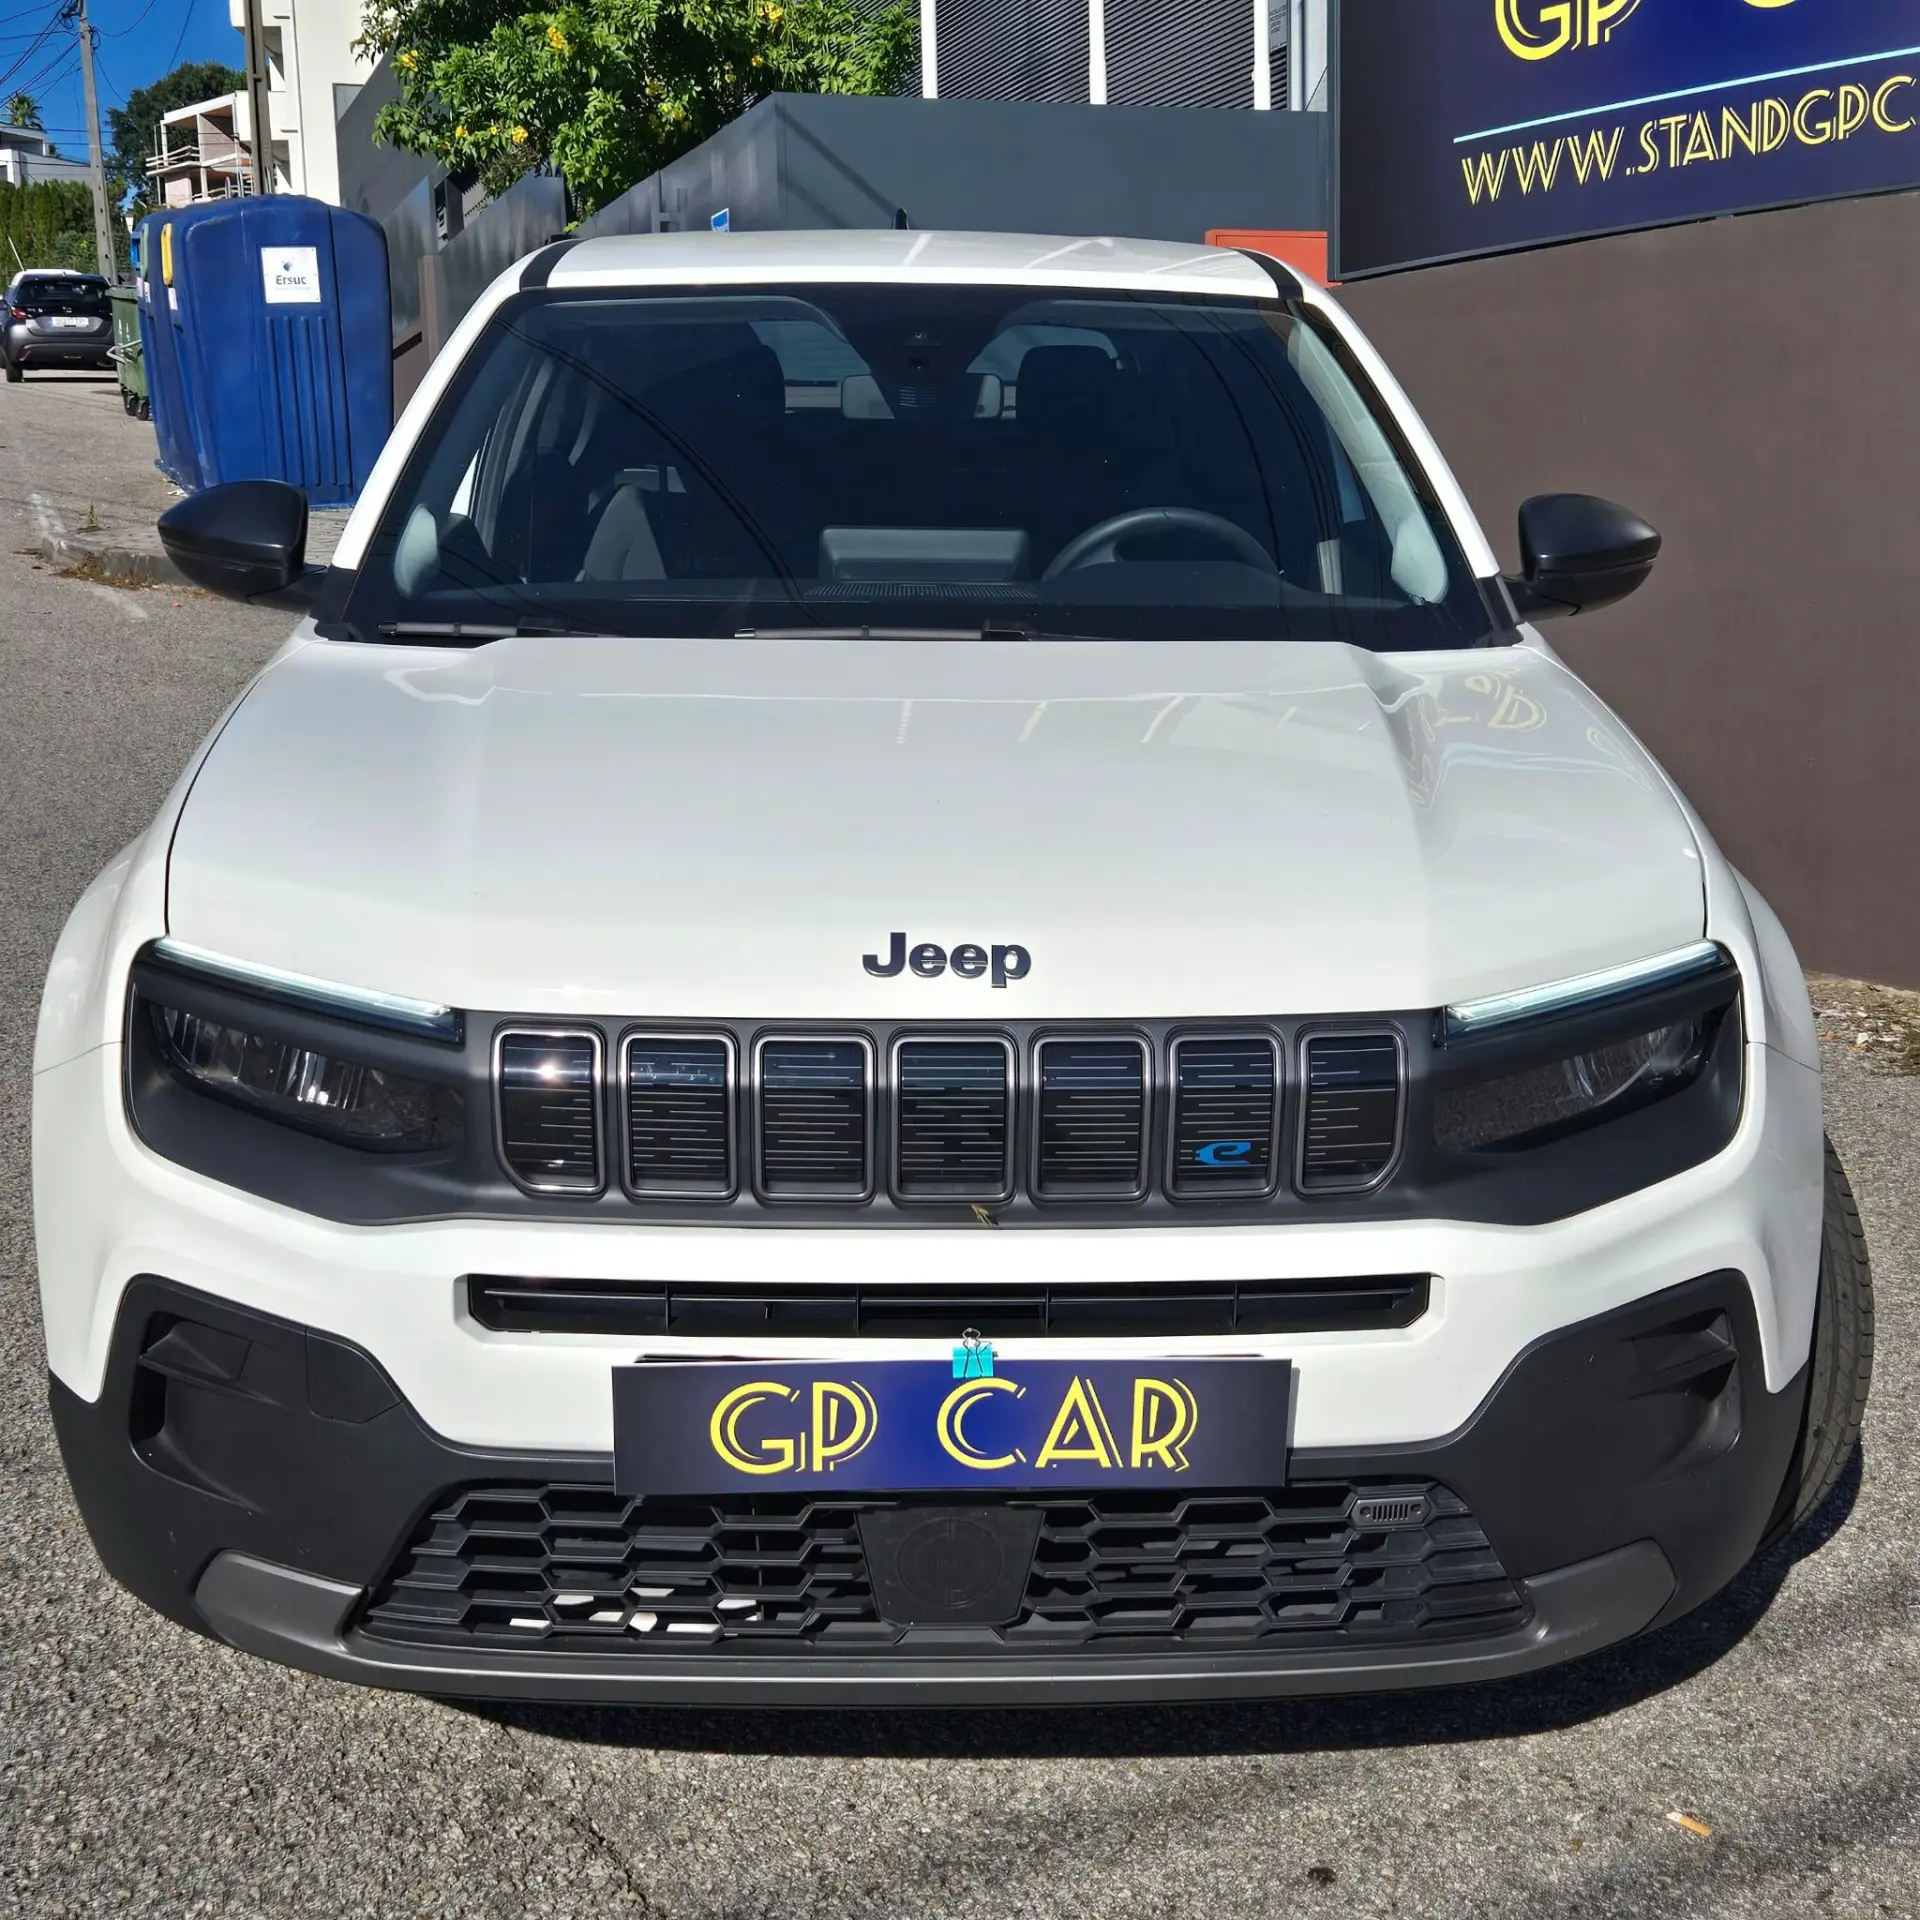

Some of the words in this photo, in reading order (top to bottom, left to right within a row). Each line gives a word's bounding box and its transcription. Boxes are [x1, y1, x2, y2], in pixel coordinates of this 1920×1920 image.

[275, 274, 307, 285] Ersuc
[862, 932, 1032, 988] Jeep
[710, 1380, 878, 1475] GP
[936, 1375, 1198, 1472] CAR
